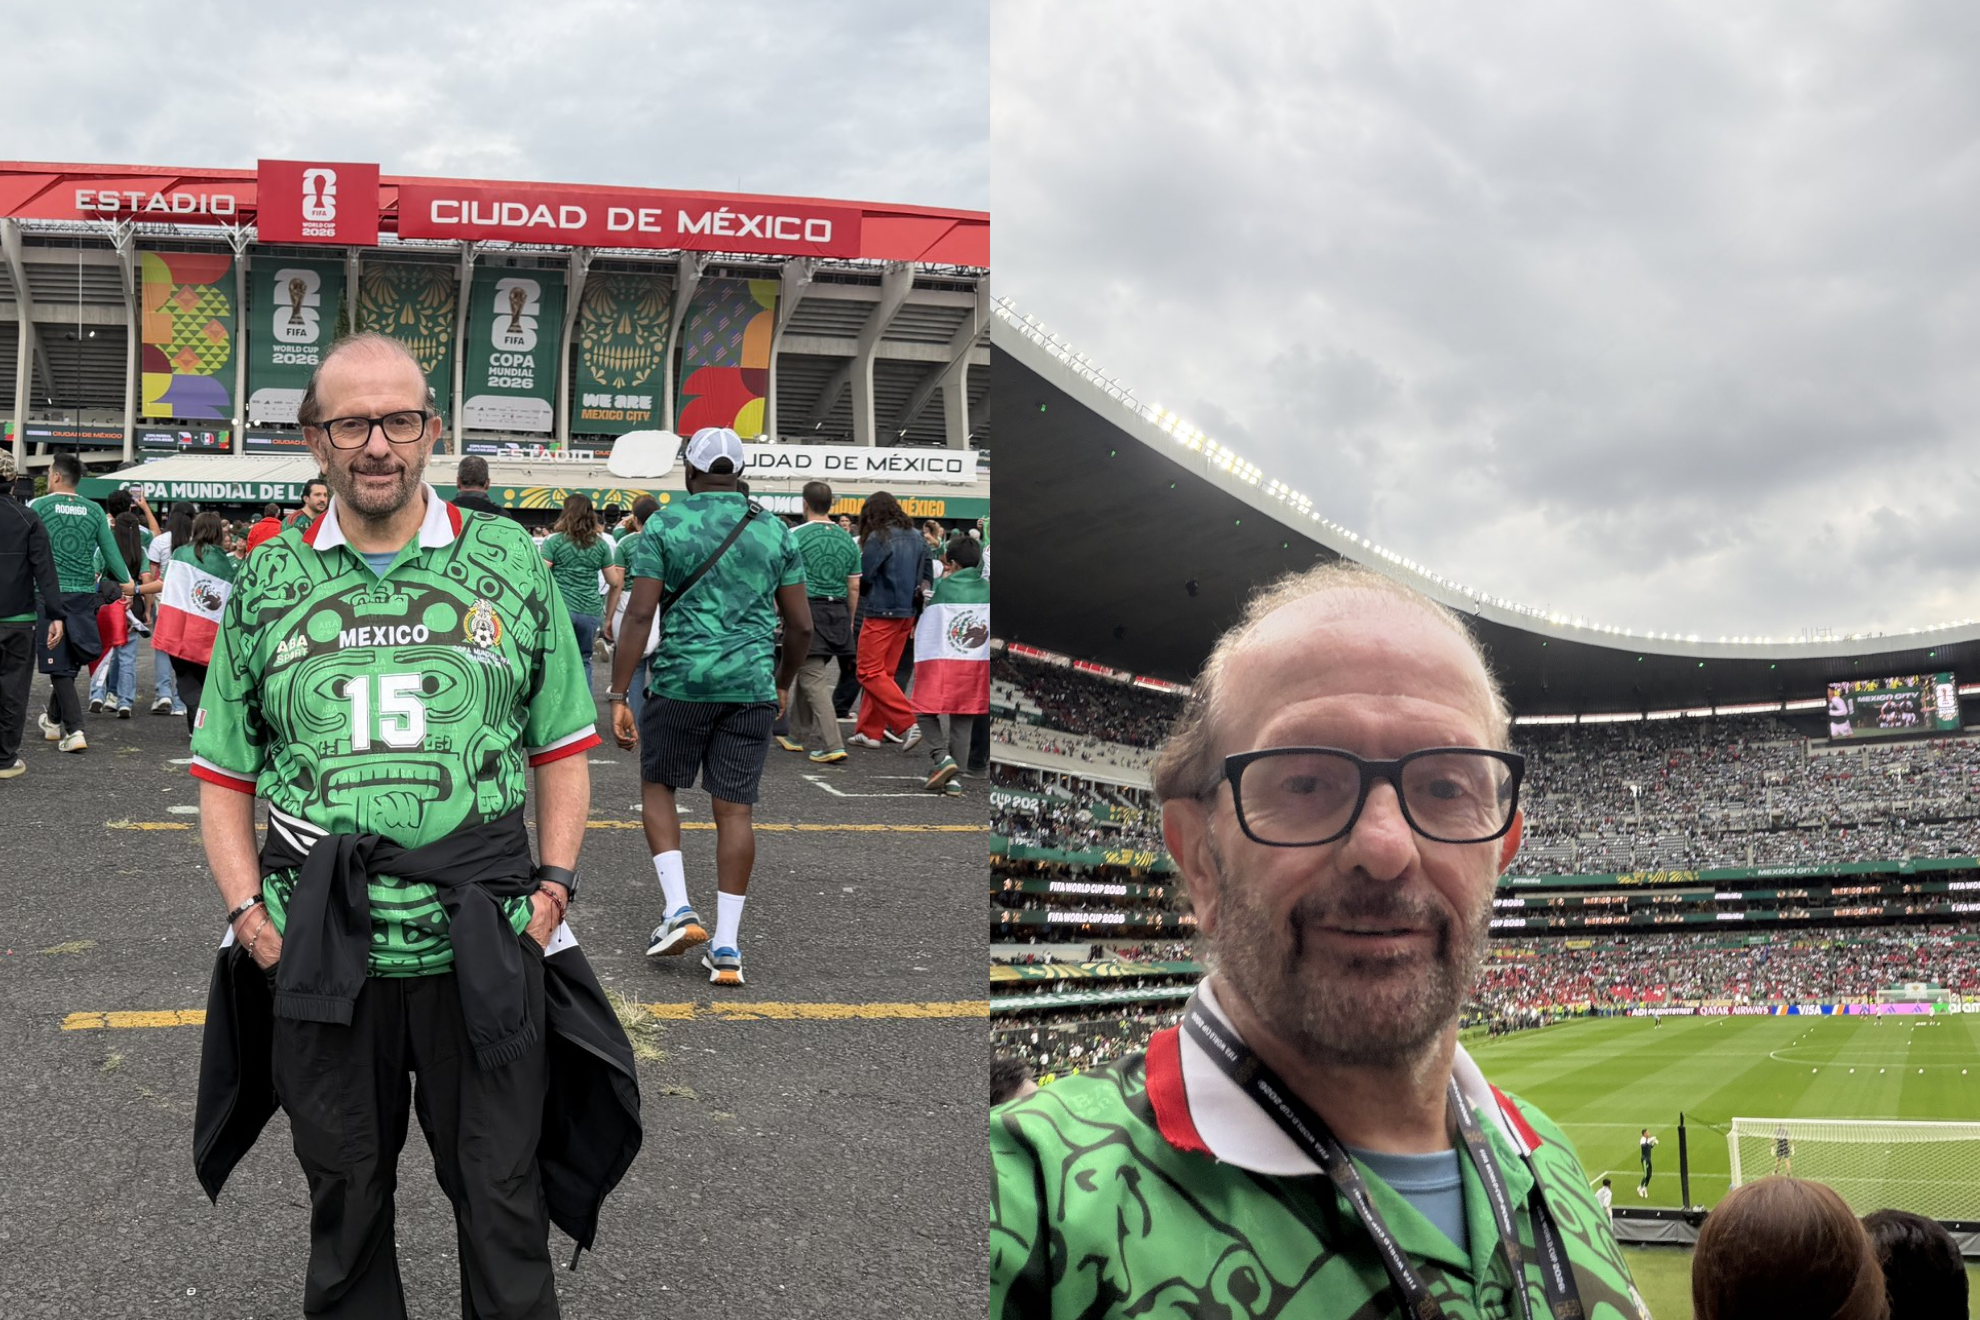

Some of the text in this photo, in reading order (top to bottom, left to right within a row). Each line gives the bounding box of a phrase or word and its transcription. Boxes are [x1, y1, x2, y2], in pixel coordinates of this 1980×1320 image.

[75, 188, 235, 215] ESTADIO
[430, 200, 832, 243] CIUDAD DE MÉXICO
[302, 228, 336, 238] 2026
[286, 328, 307, 337] FIFA
[504, 336, 525, 345] FIFA
[272, 345, 319, 354] WORLD CUP
[272, 353, 319, 365] 2026
[489, 353, 535, 368] COPA
[488, 367, 534, 377] MUNDIAL
[487, 377, 534, 389] 2026
[582, 393, 653, 410] WE ARE
[581, 409, 651, 423] MEXICO CITY
[497, 448, 594, 463] ESTADIO
[825, 455, 858, 470] DE
[866, 453, 962, 473] MÉXICO
[171, 483, 256, 499] MUNDIAL
[259, 485, 285, 500] DE
[55, 503, 88, 516] RODRIGO
[339, 624, 429, 649] MEXICO
[276, 635, 308, 653] ABA
[275, 648, 309, 664] SPORT
[1857, 691, 1919, 703] MEXICO CITY
[343, 672, 427, 751] 15
[990, 791, 1012, 806] CUP
[1757, 868, 1796, 876] MEXICO
[1050, 881, 1127, 895] FIFA WORLD CUP 2026
[1831, 886, 1881, 896] MEXICO CITY
[1948, 882, 1965, 891] FIFA
[1583, 896, 1629, 905] MEXICO CITY
[1048, 912, 1126, 924] FIFA WORLD CUP 2026
[1584, 916, 1631, 925] MEXICO CITY
[1700, 1005, 1769, 1016] QATAR AIRWAYS
[1796, 1004, 1822, 1015] VISA
[1258, 1079, 1330, 1160] FIFA WORLD CUP 2026
[1371, 1221, 1386, 1239] CUP
[1384, 1236, 1404, 1270] WORLD
[1549, 1247, 1558, 1263] CUP
[1403, 1269, 1417, 1291] FIFA
